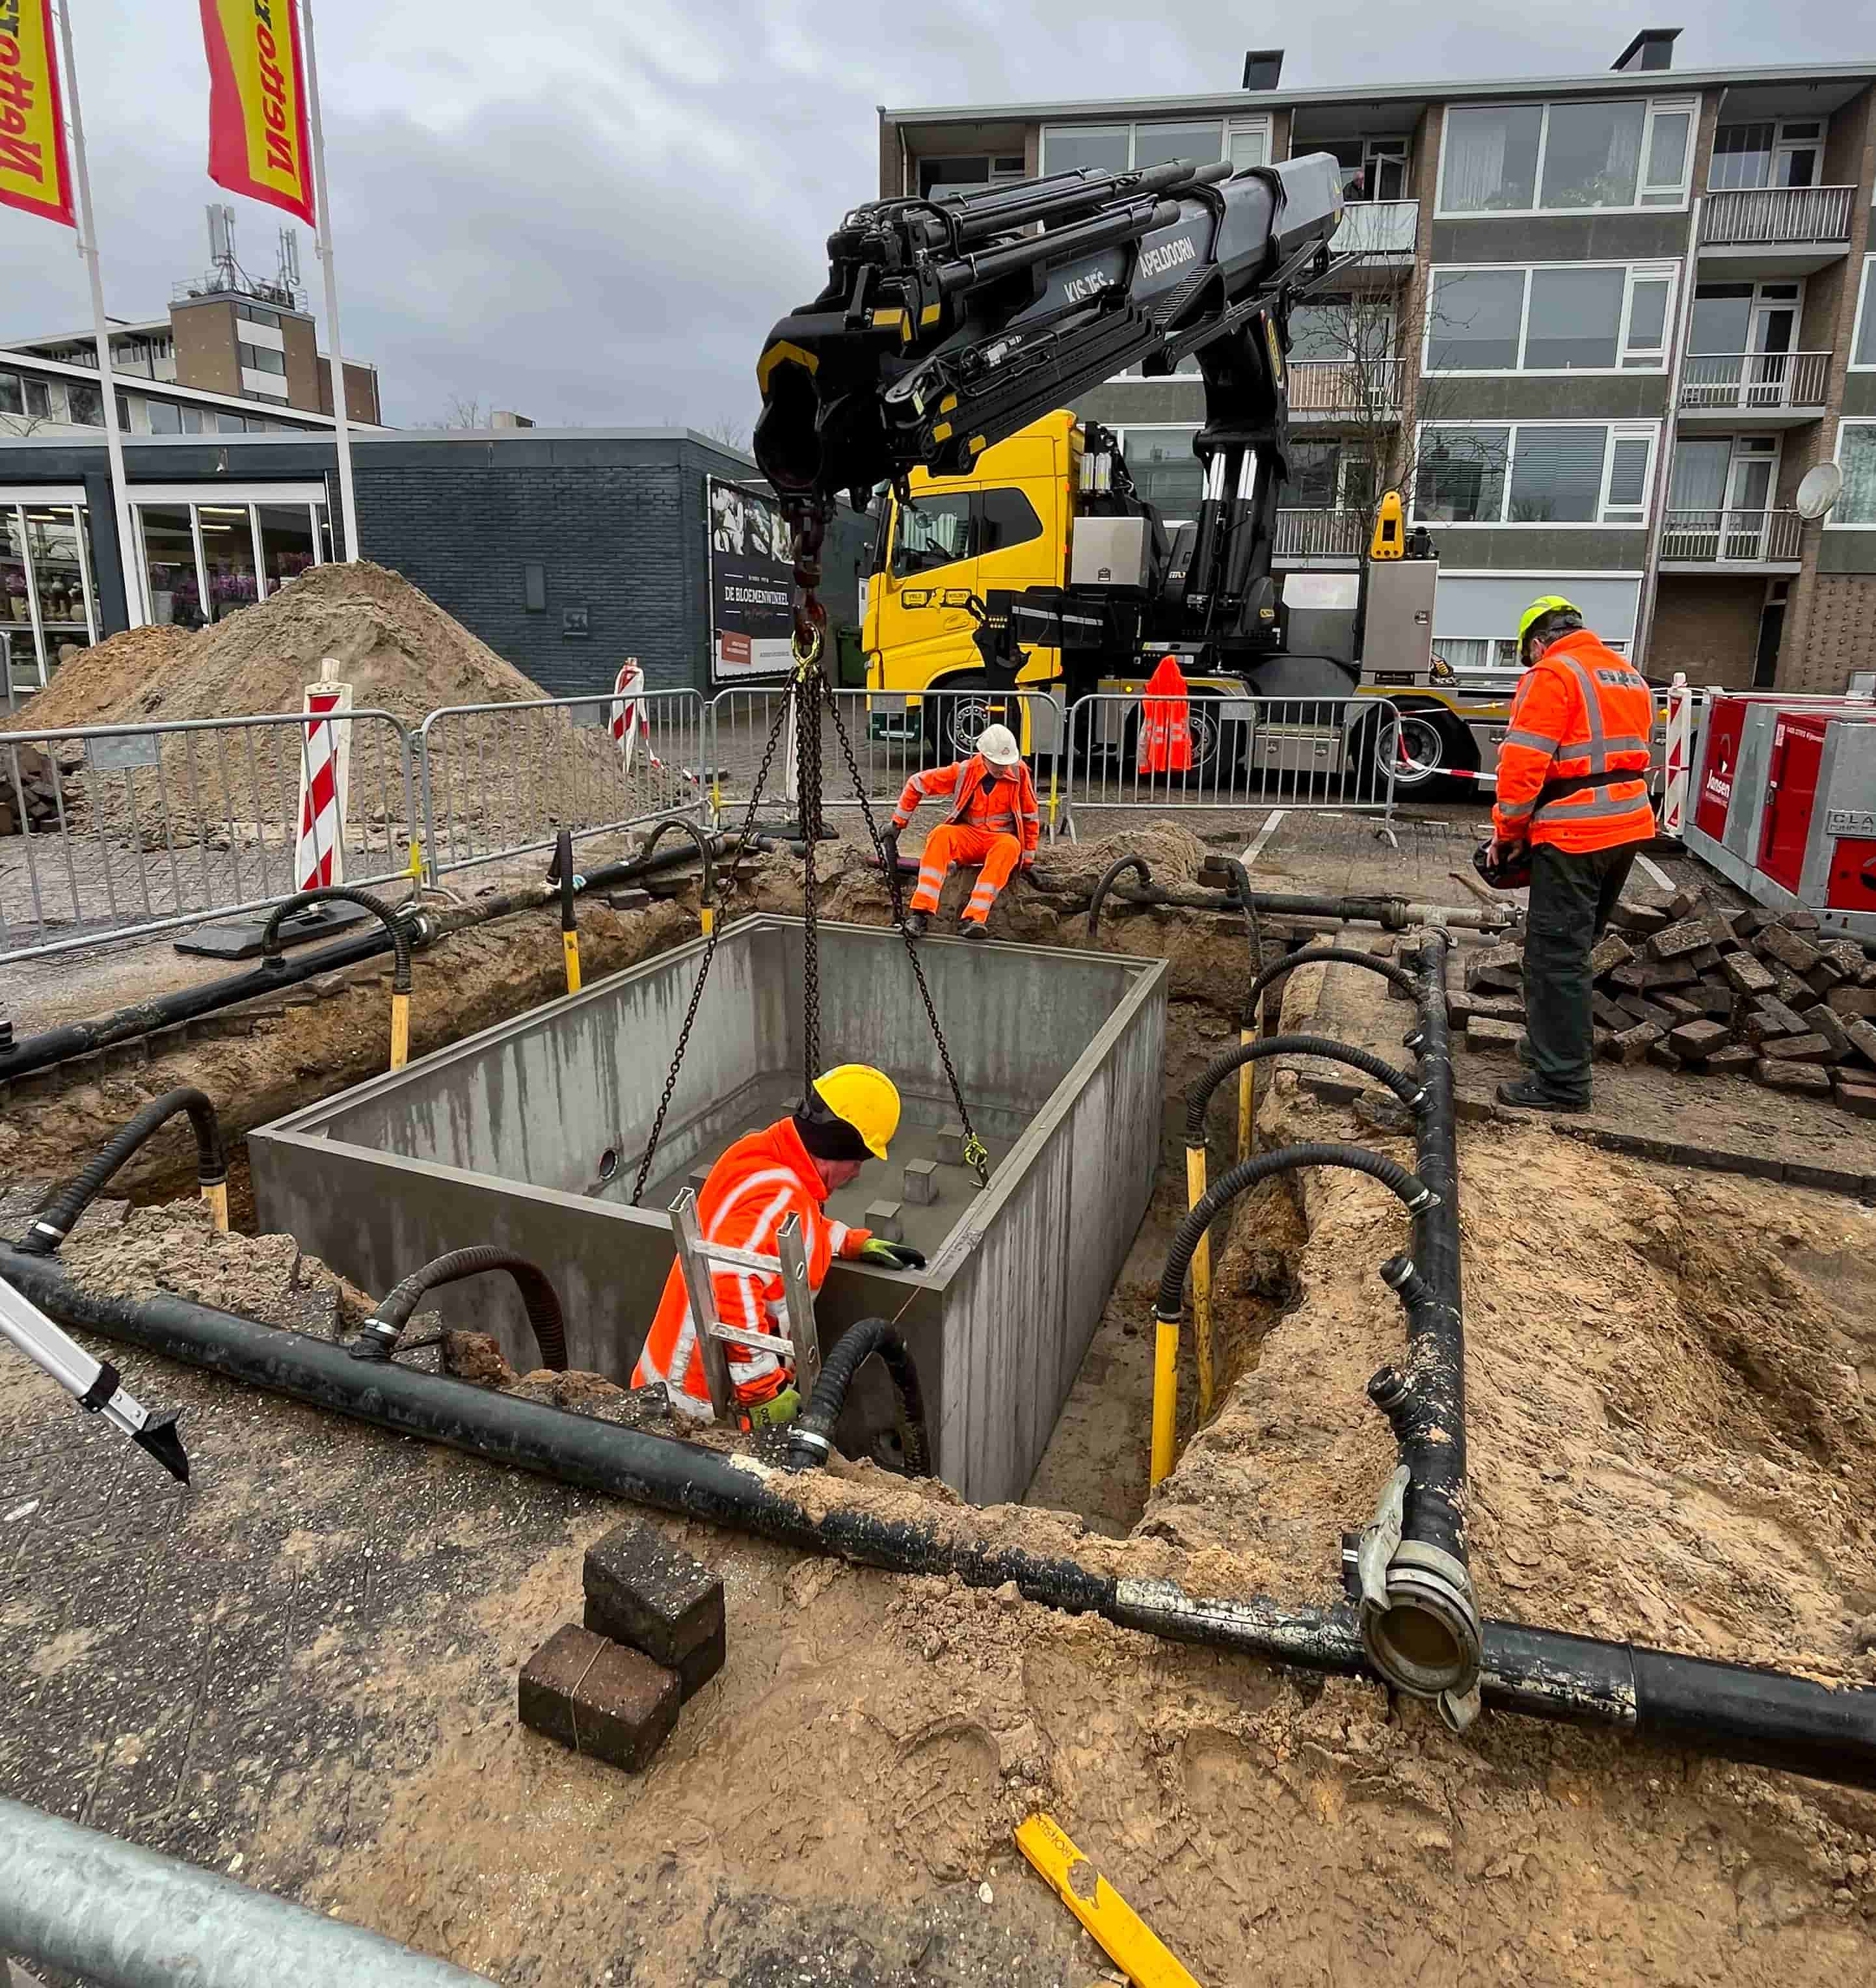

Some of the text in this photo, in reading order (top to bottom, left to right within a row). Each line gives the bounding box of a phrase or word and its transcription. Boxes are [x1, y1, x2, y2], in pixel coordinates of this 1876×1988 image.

[1139, 236, 1196, 278] APELDOORN
[724, 586, 788, 605] DE BLOEMENWINKEL
[1707, 769, 1730, 798] Jansen
